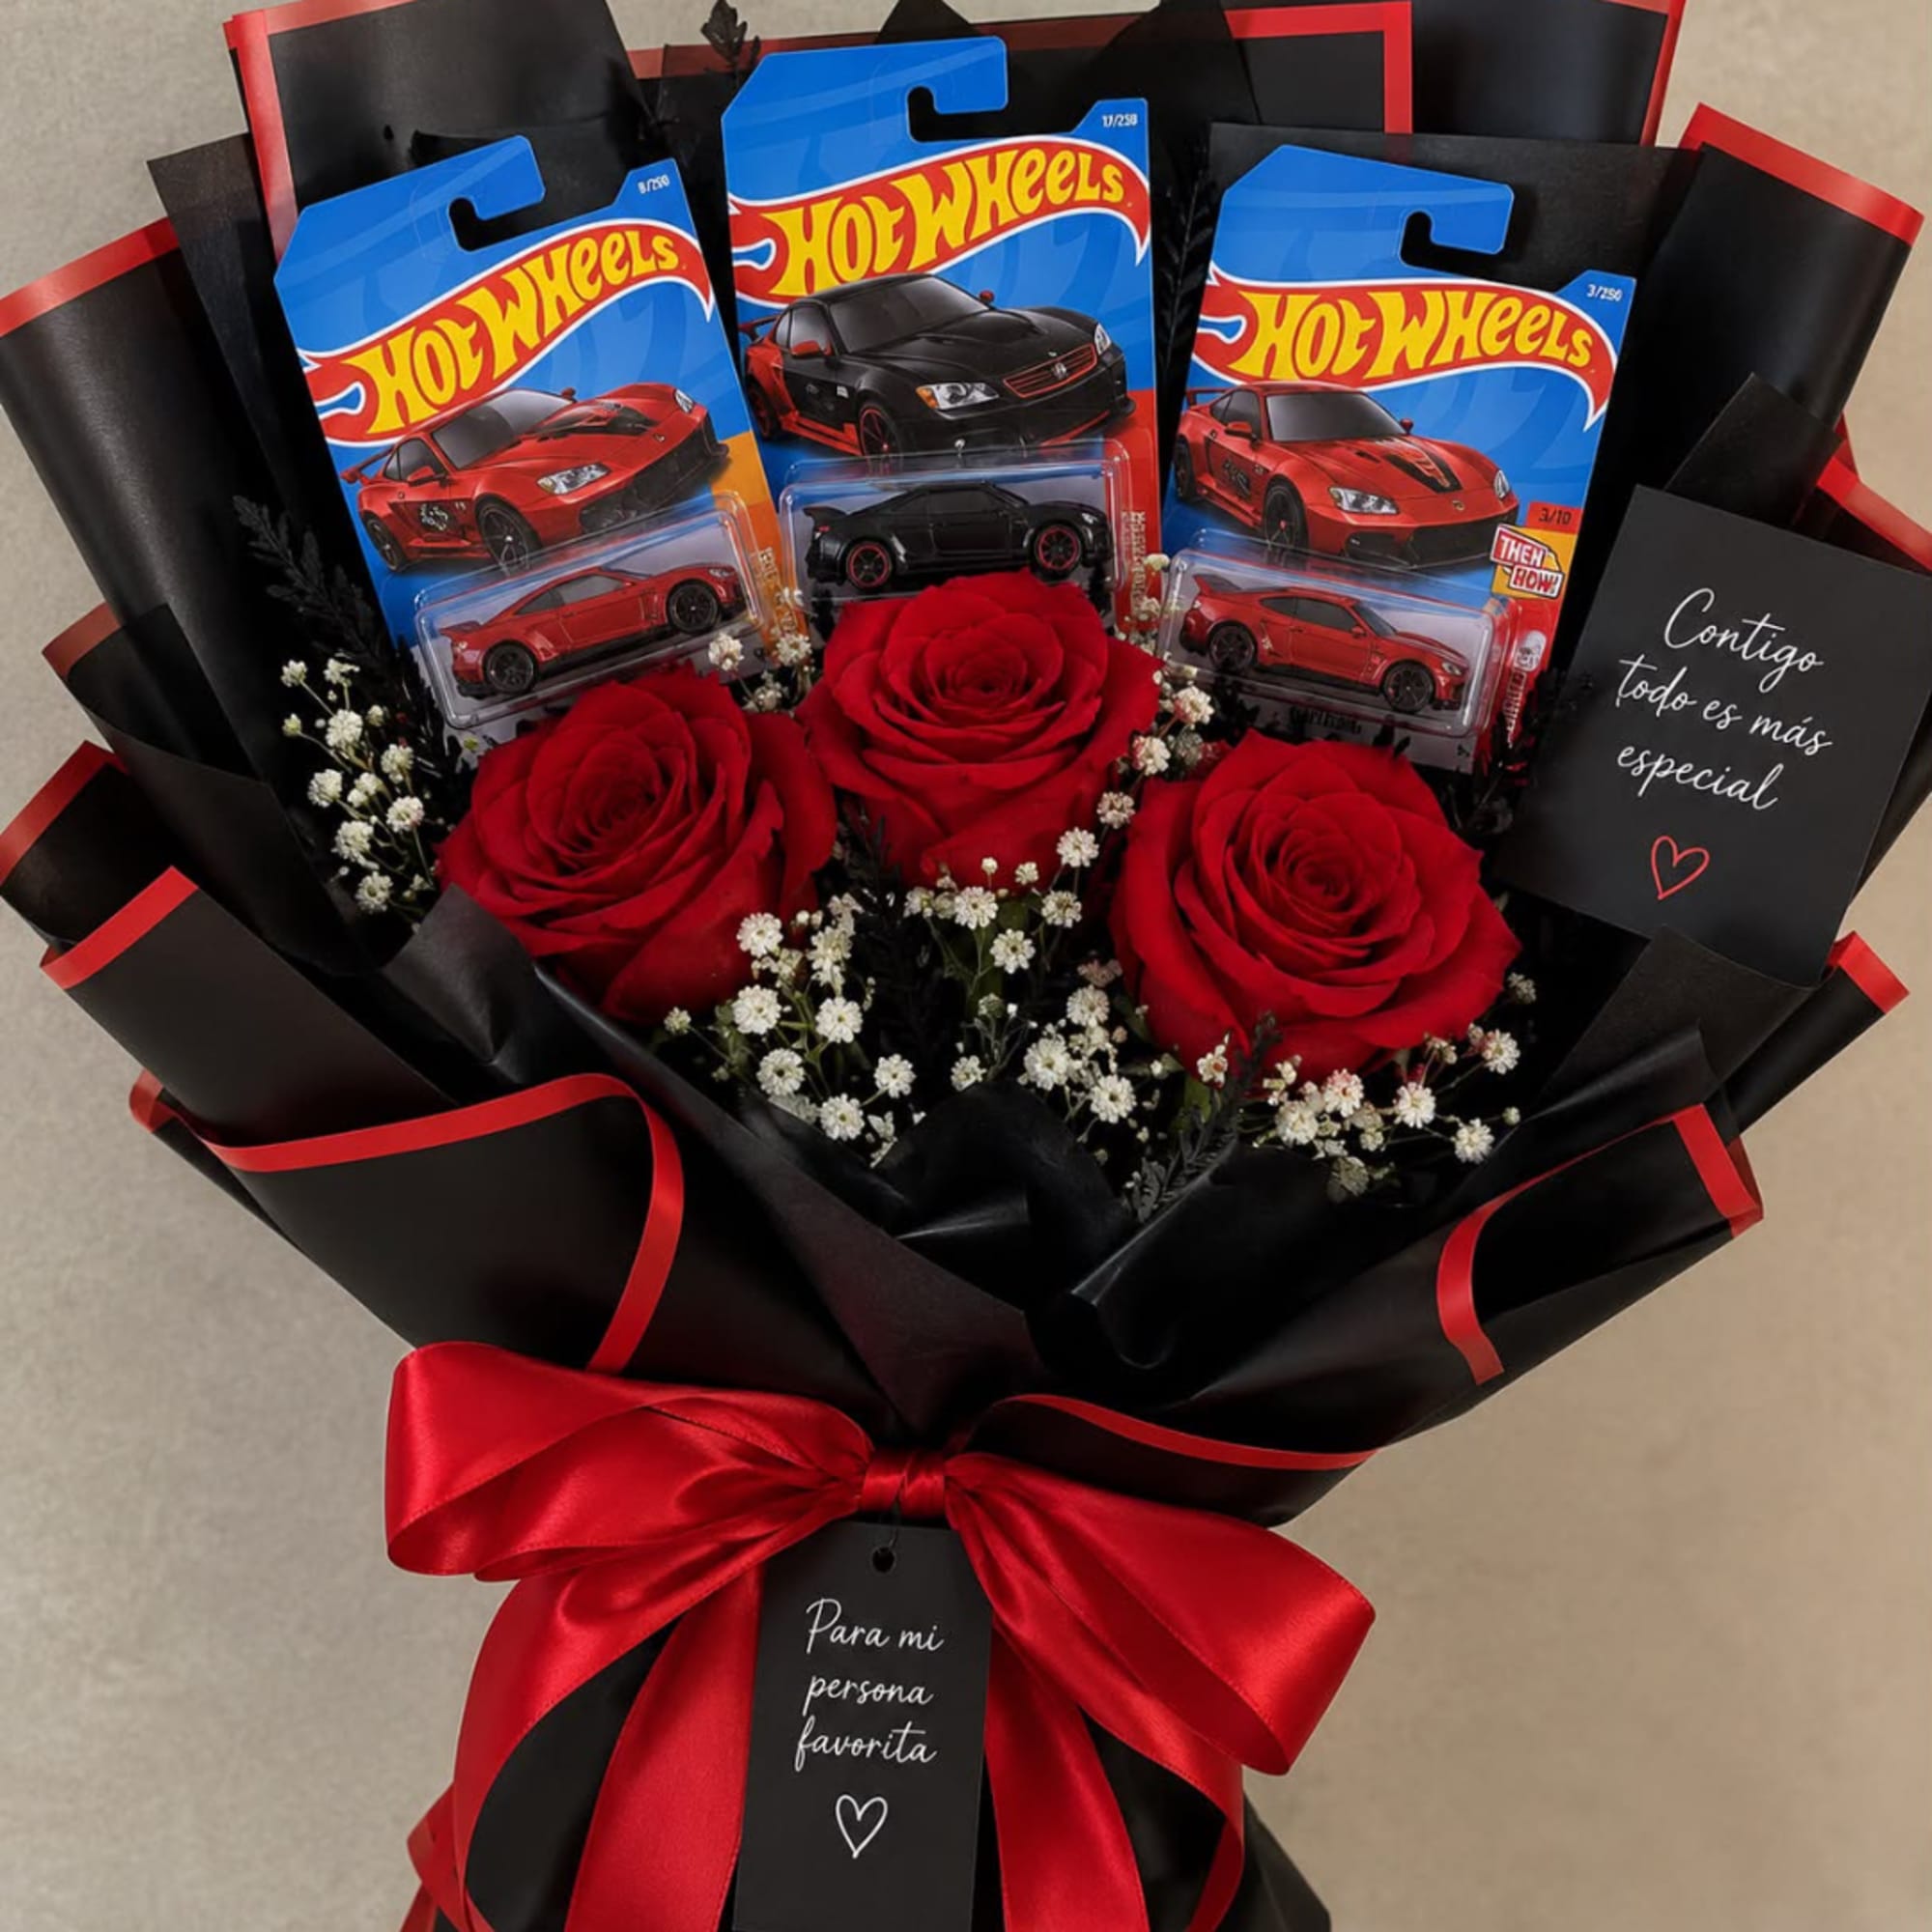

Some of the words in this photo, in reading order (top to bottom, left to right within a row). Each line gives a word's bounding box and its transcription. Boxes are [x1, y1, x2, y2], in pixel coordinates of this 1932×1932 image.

[1499, 534, 1545, 567] THEN
[1664, 587, 1824, 693] Contigo
[1616, 654, 1696, 717] todo
[1702, 699, 1742, 730] es
[1749, 717, 1833, 755] más
[1617, 745, 1784, 810] especial
[806, 1598, 890, 1654] Para
[898, 1625, 945, 1651] mi
[803, 1675, 934, 1717] persona
[794, 1715, 937, 1772] favorita
